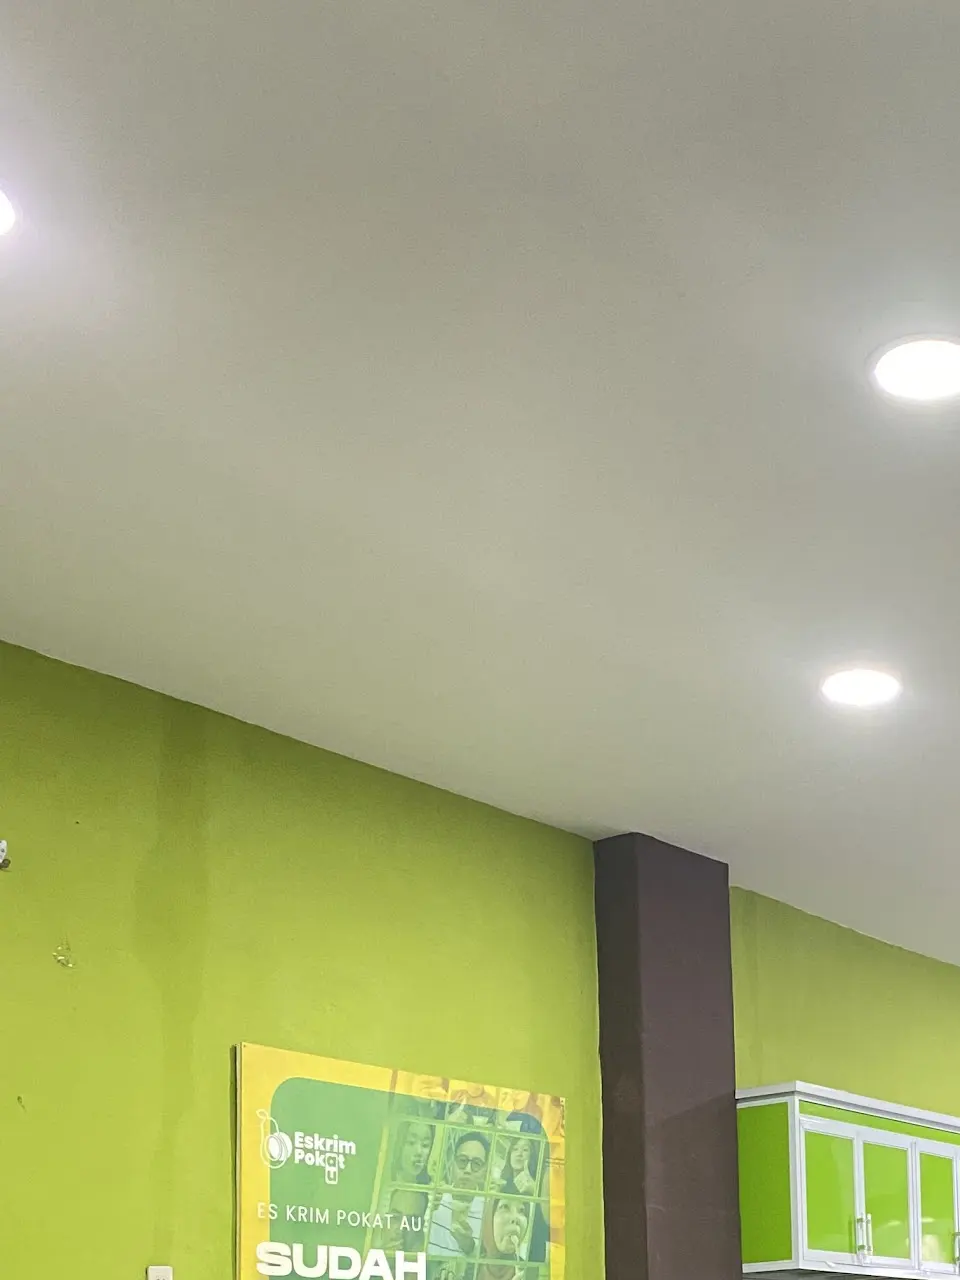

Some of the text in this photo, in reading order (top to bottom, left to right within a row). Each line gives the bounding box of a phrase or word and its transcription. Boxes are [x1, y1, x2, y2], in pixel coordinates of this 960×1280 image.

[294, 1131, 357, 1156] Eskrim
[294, 1148, 346, 1170] Pokat
[257, 1202, 278, 1220] ES
[286, 1204, 330, 1225] KRIM
[336, 1209, 394, 1230] POKAT
